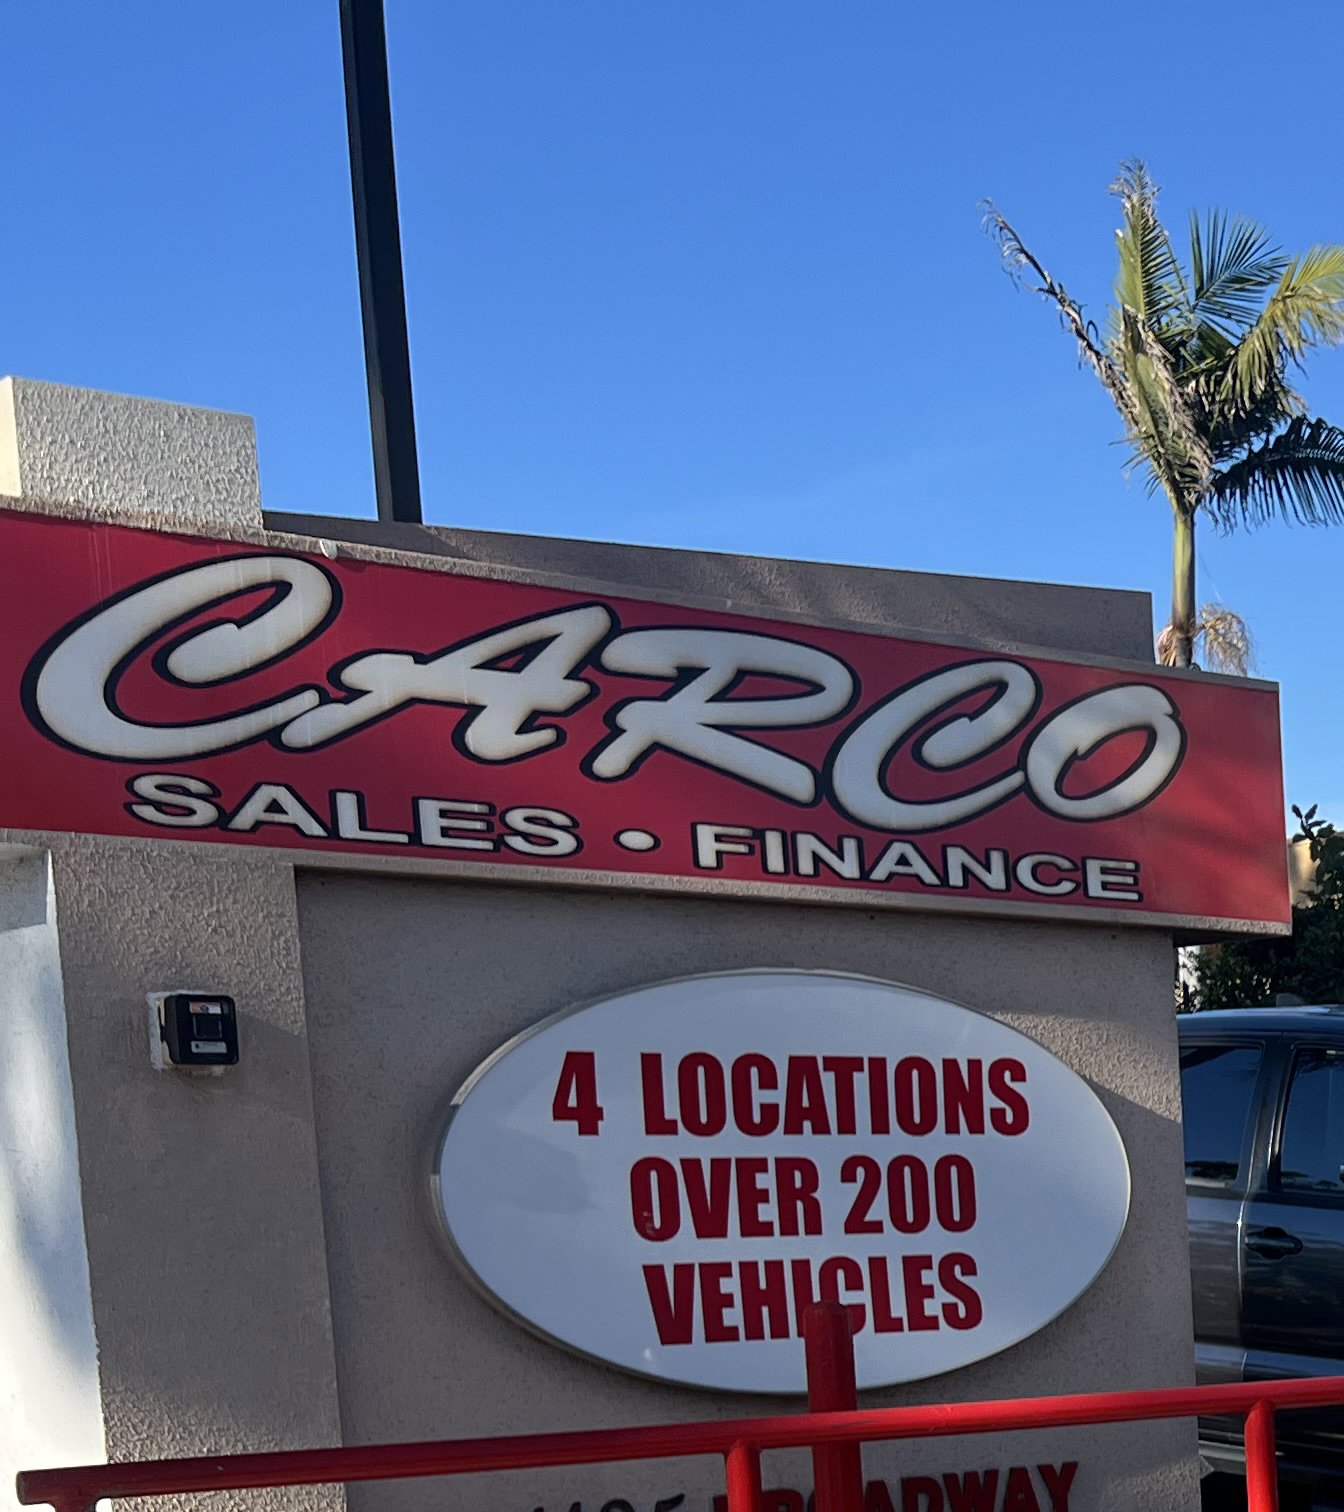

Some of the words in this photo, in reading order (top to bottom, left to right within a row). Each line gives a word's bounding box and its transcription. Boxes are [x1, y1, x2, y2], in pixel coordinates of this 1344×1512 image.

[22, 552, 1188, 832] CARCO
[126, 772, 584, 857] SALES
[692, 822, 1143, 901] FINANCE
[552, 1050, 604, 1136] 4
[640, 1051, 1031, 1137] LOCATIONS
[630, 1154, 822, 1242] OVER
[840, 1153, 977, 1235] 200
